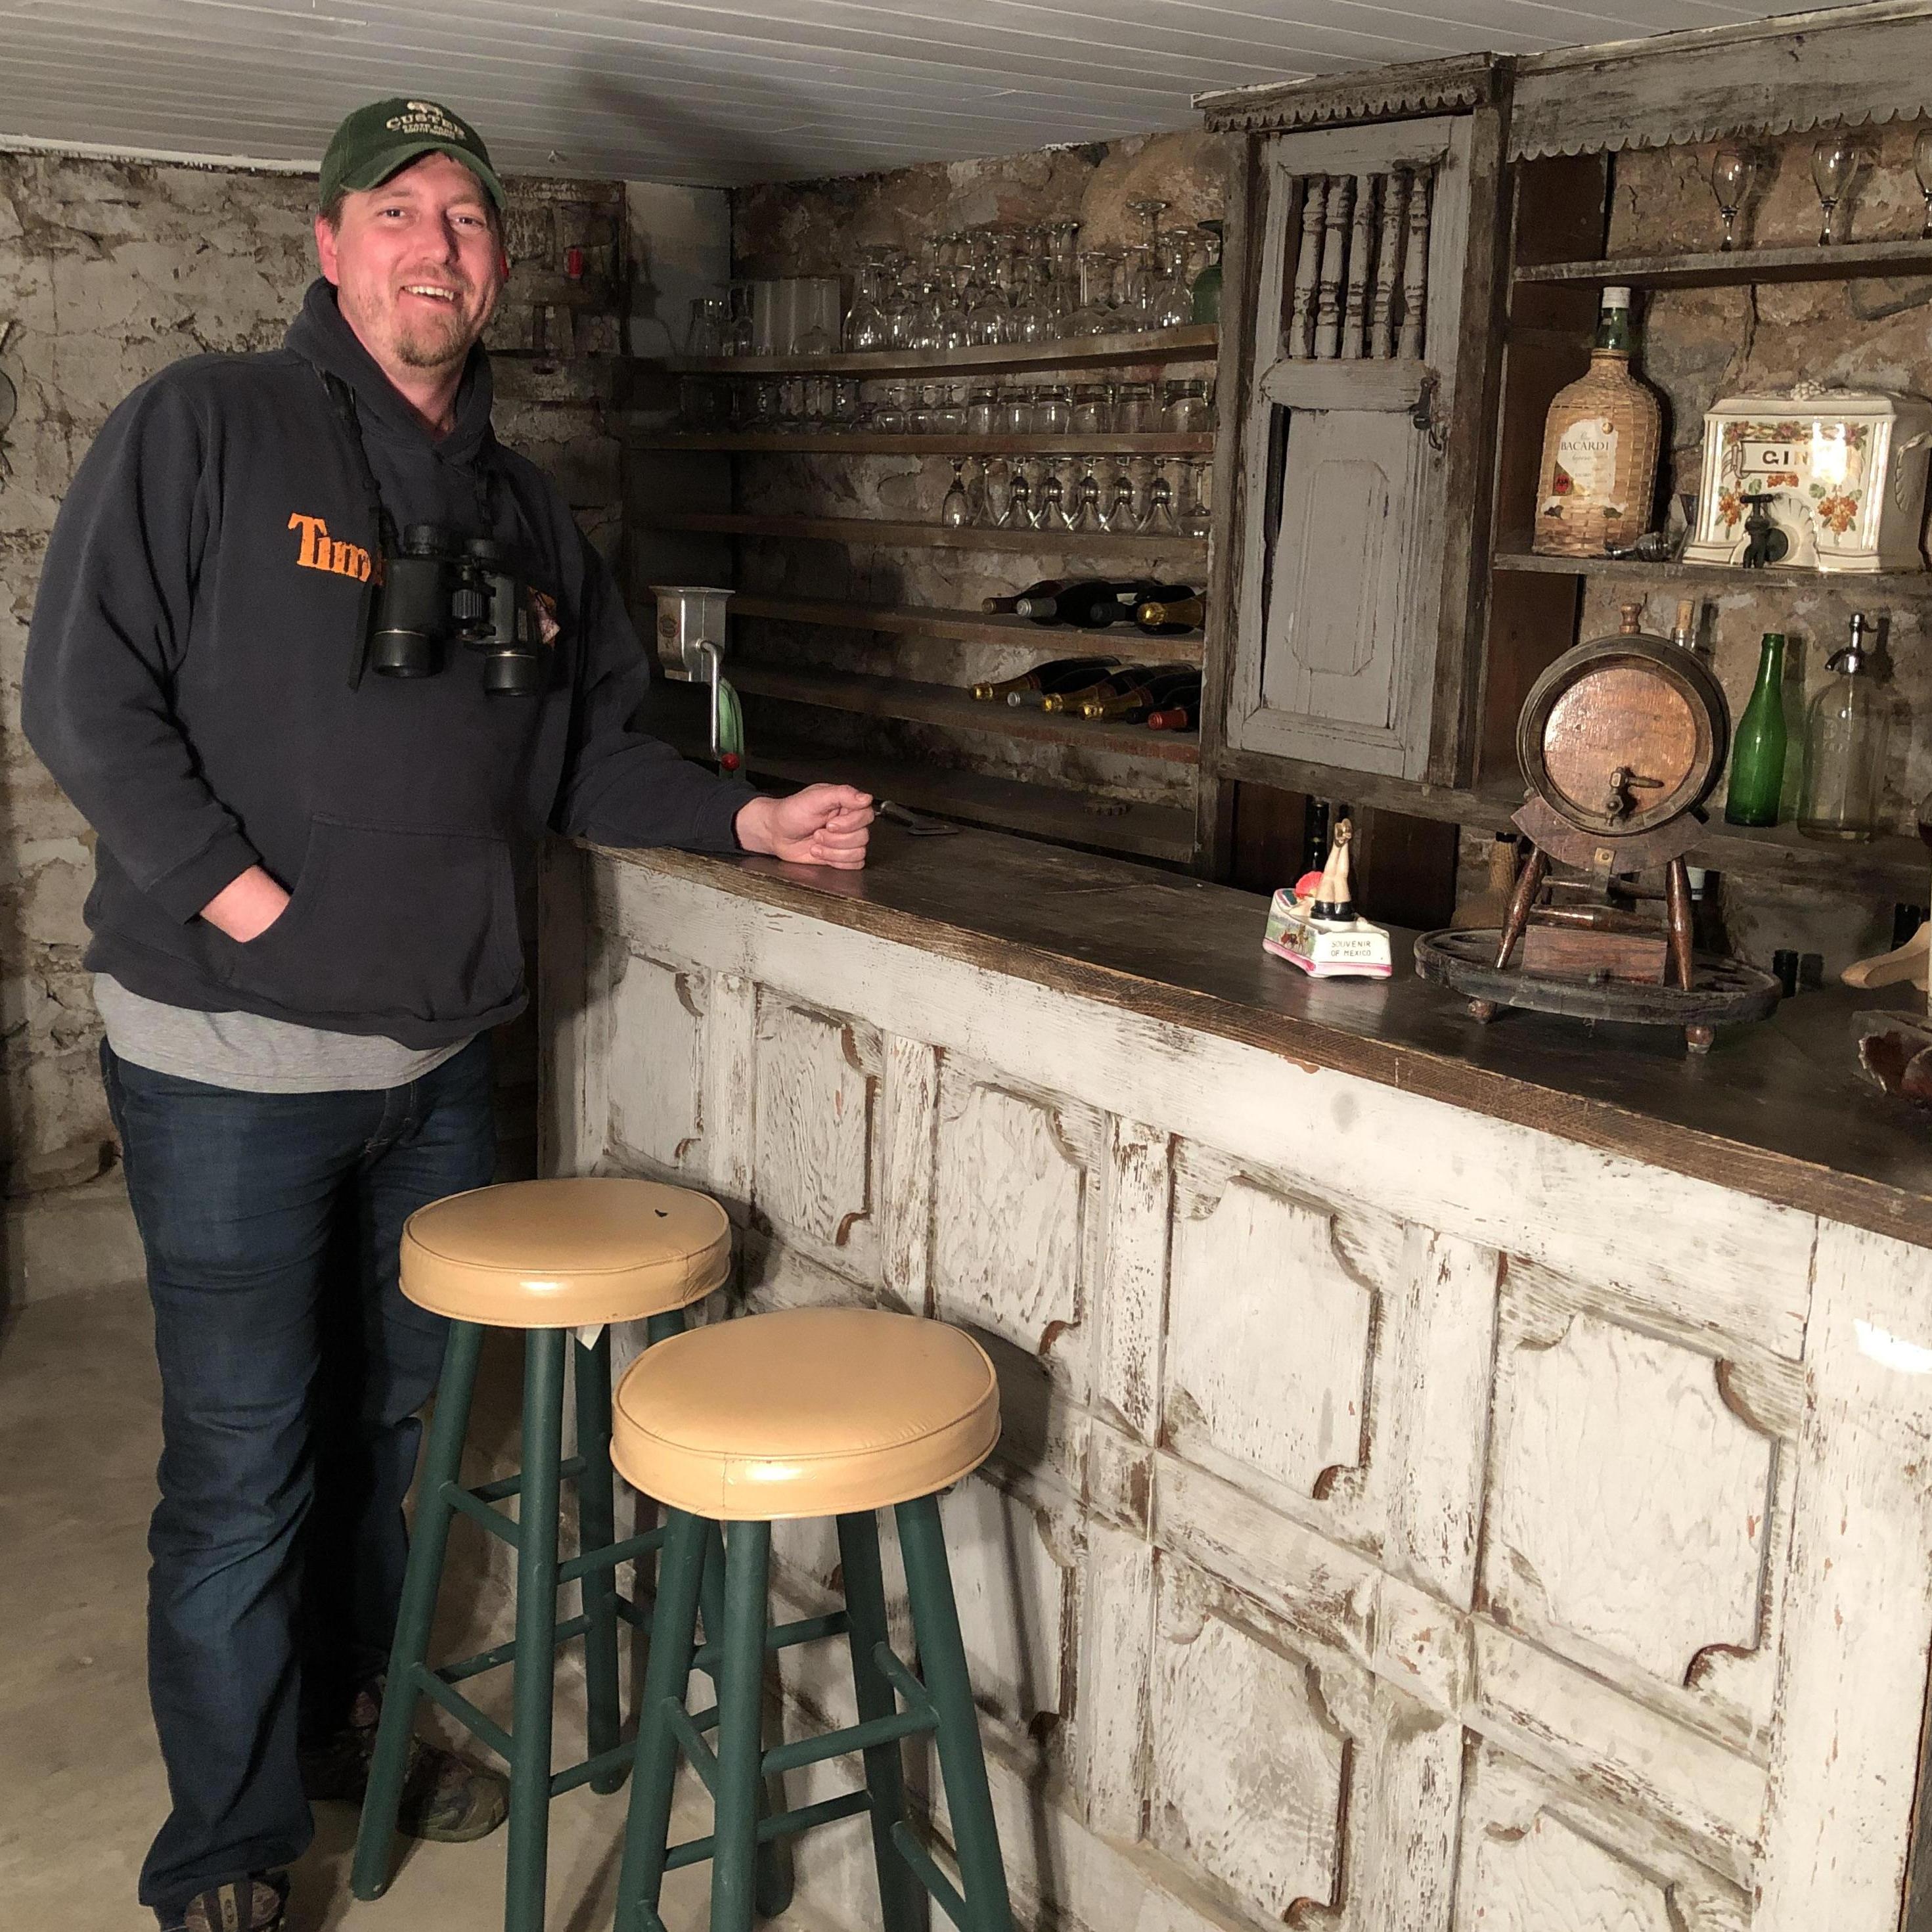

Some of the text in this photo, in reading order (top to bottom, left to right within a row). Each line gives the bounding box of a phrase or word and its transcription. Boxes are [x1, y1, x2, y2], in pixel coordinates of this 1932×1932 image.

[1561, 441, 1609, 451] BACARDI
[1762, 450, 1808, 465] GIN
[288, 512, 384, 585] Tim
